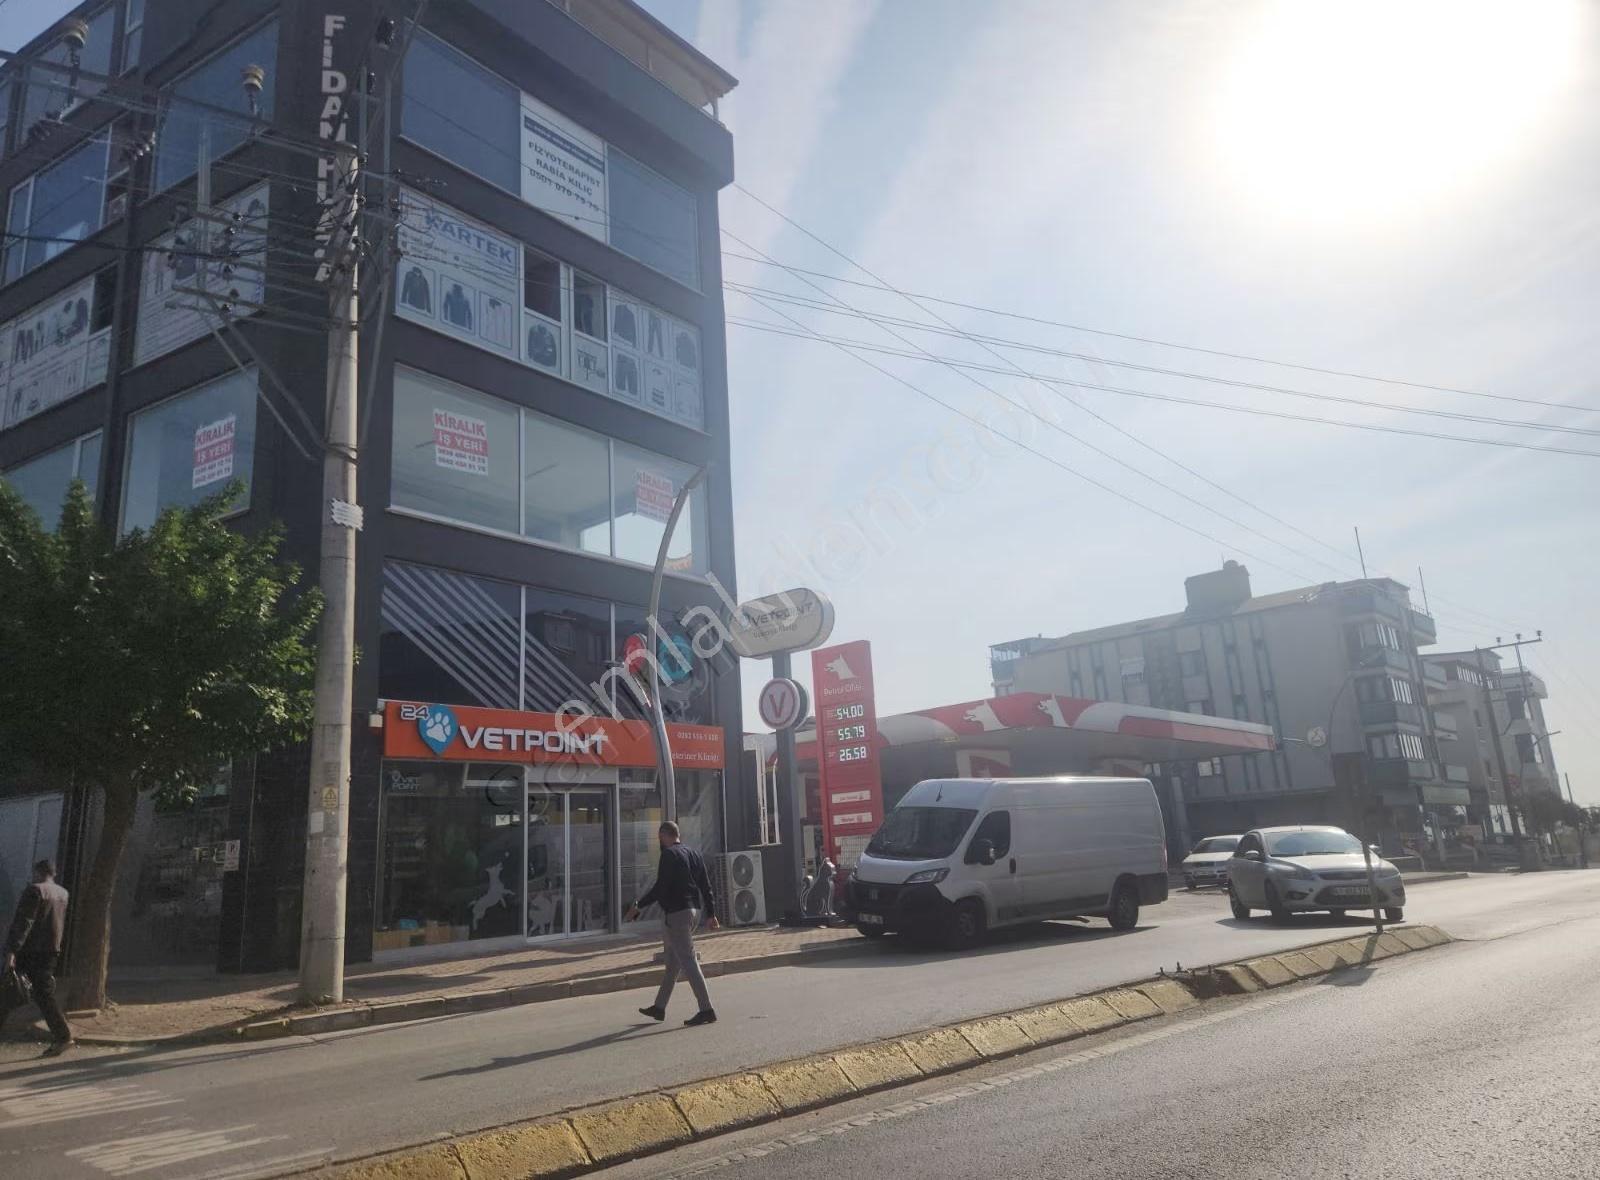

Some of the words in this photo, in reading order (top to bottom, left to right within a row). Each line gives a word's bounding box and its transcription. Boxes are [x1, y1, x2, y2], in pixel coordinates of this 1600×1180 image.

[434, 411, 485, 438] KİRALIK
[400, 705, 429, 720] 24
[768, 692, 786, 719] V
[460, 725, 608, 754] VETPOINT
[839, 746, 867, 762] 26.58
